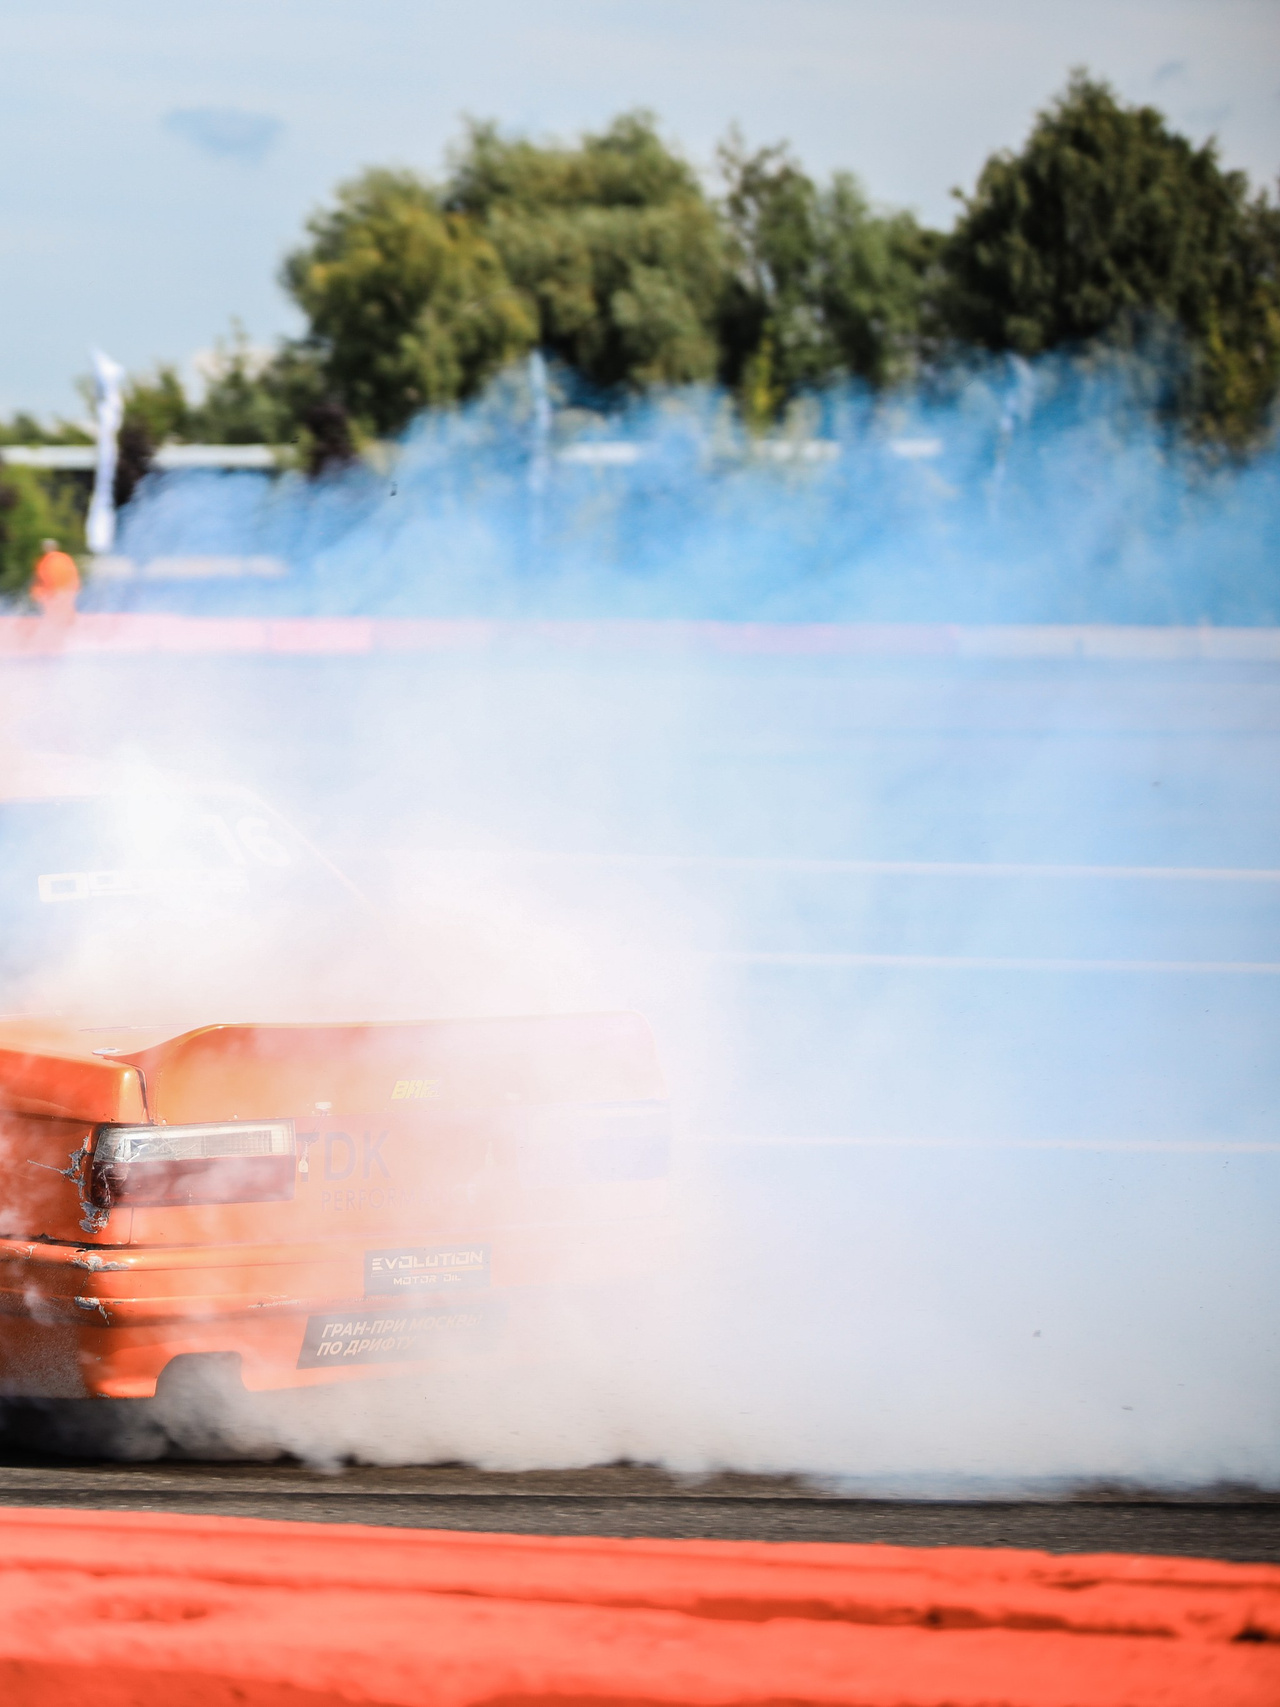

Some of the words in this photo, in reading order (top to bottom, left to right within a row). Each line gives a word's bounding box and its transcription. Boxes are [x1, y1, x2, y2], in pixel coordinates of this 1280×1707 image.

[200, 814, 291, 867] 16
[296, 1130, 392, 1182] TDK
[321, 1184, 465, 1212] PERFORM
[371, 1250, 483, 1271] EVOLUTION
[393, 1274, 437, 1286] MOTOR
[443, 1272, 462, 1283] OIL
[322, 1318, 406, 1338] ГРАН-ПРИ
[408, 1314, 483, 1331] МОСКВЫ
[316, 1341, 343, 1357] ПО
[343, 1335, 417, 1357] ДРИФТУ
